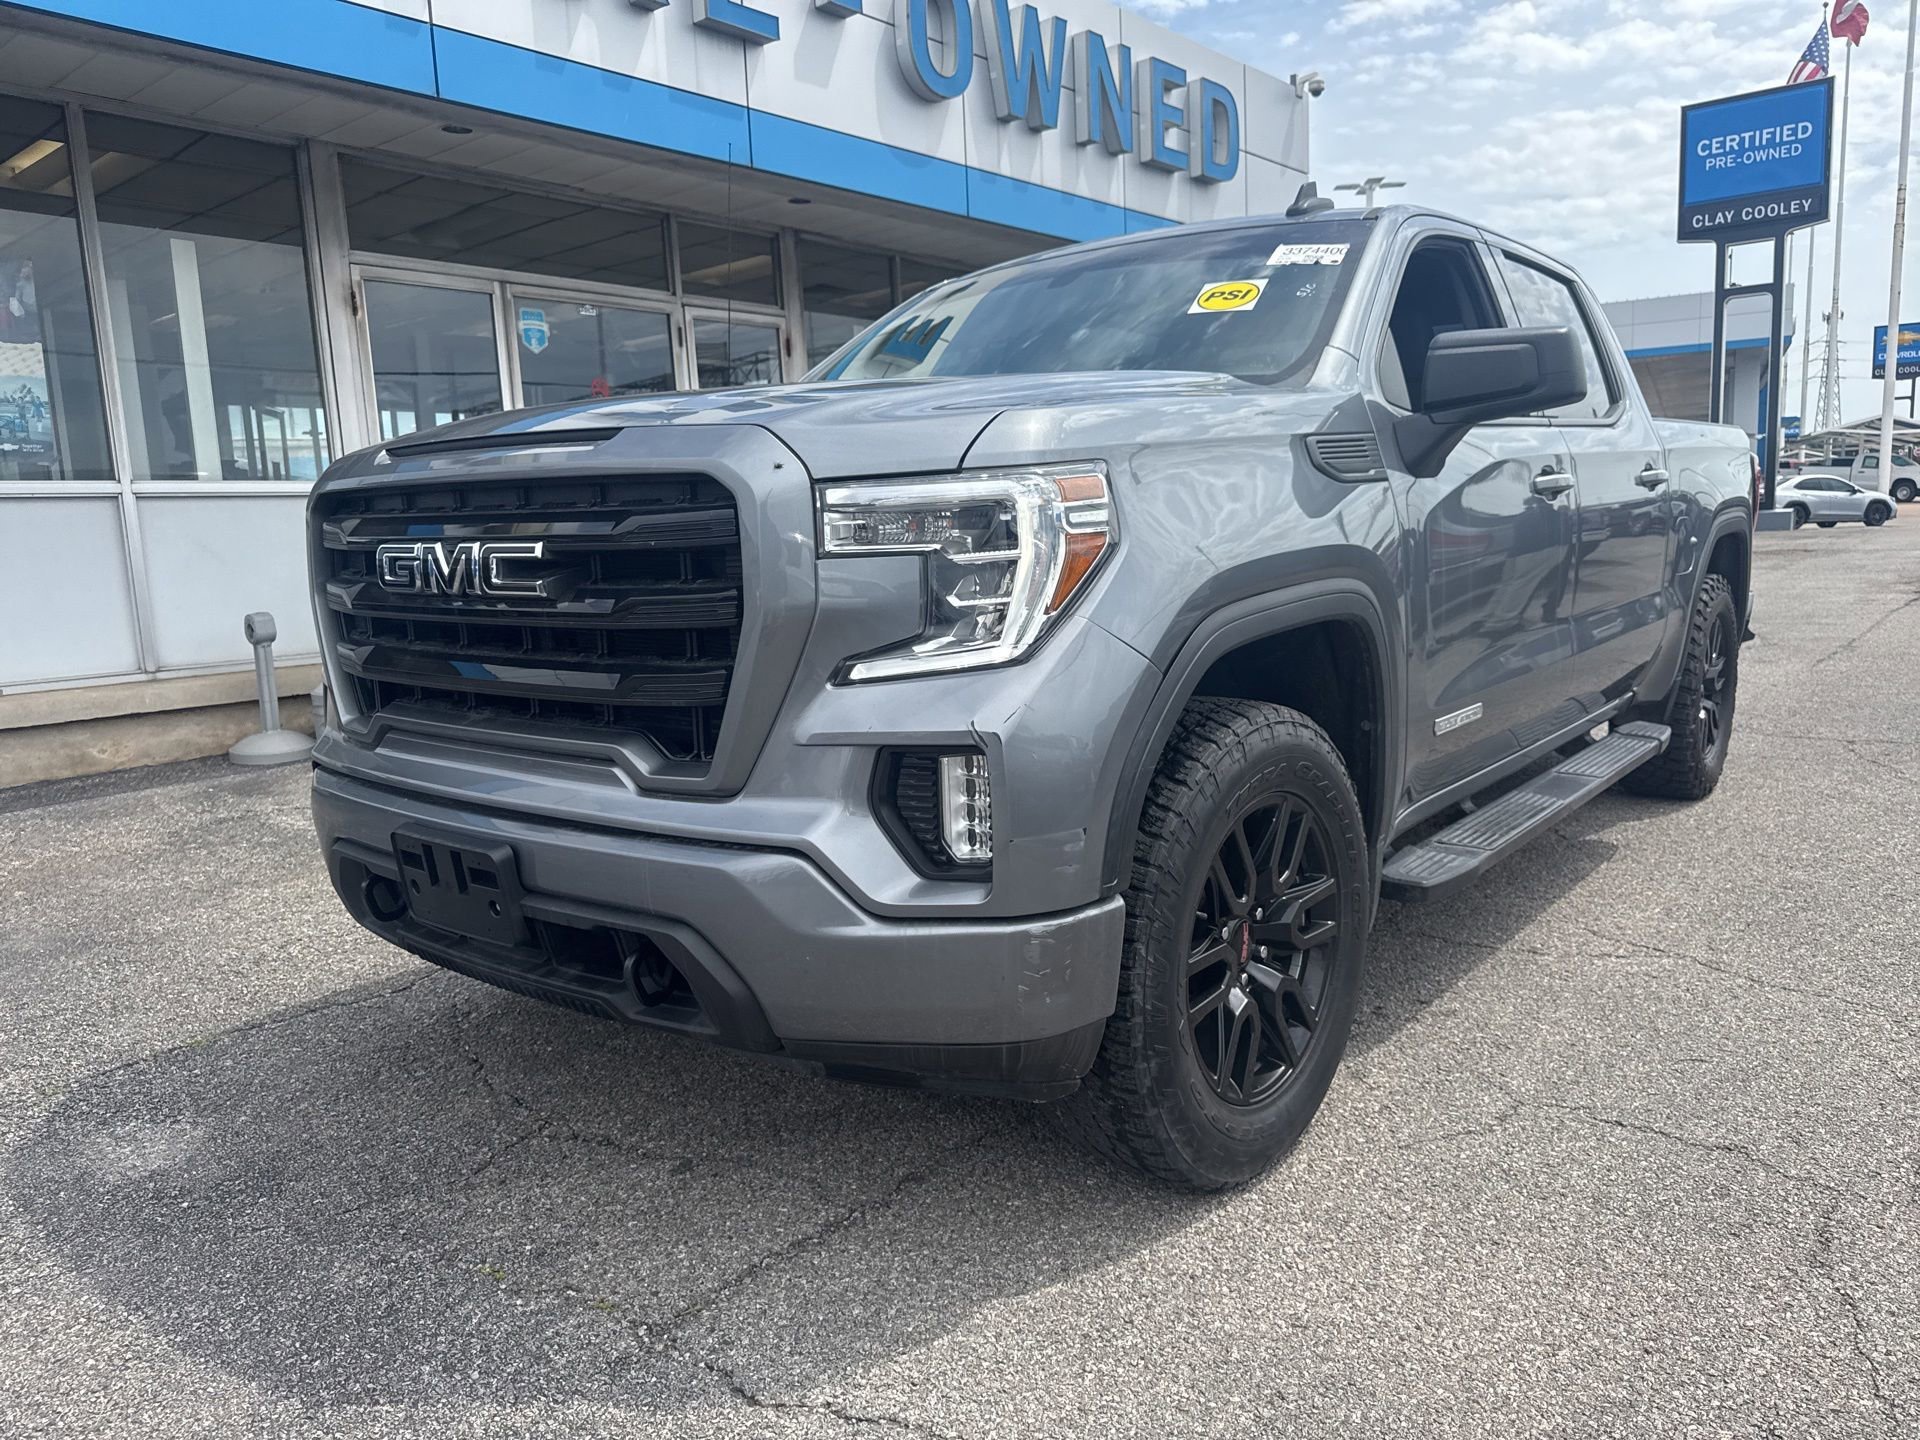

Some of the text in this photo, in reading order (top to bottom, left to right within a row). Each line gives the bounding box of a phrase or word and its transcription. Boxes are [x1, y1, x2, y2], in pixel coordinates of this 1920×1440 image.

[1697, 121, 1813, 157] CERTIFIED
[1706, 143, 1802, 171] PRE-OWNED
[1692, 198, 1812, 228] CLAY COOLEY
[1204, 290, 1253, 302] PSI
[376, 541, 547, 597] GMC
[1240, 922, 1249, 963] GMC
